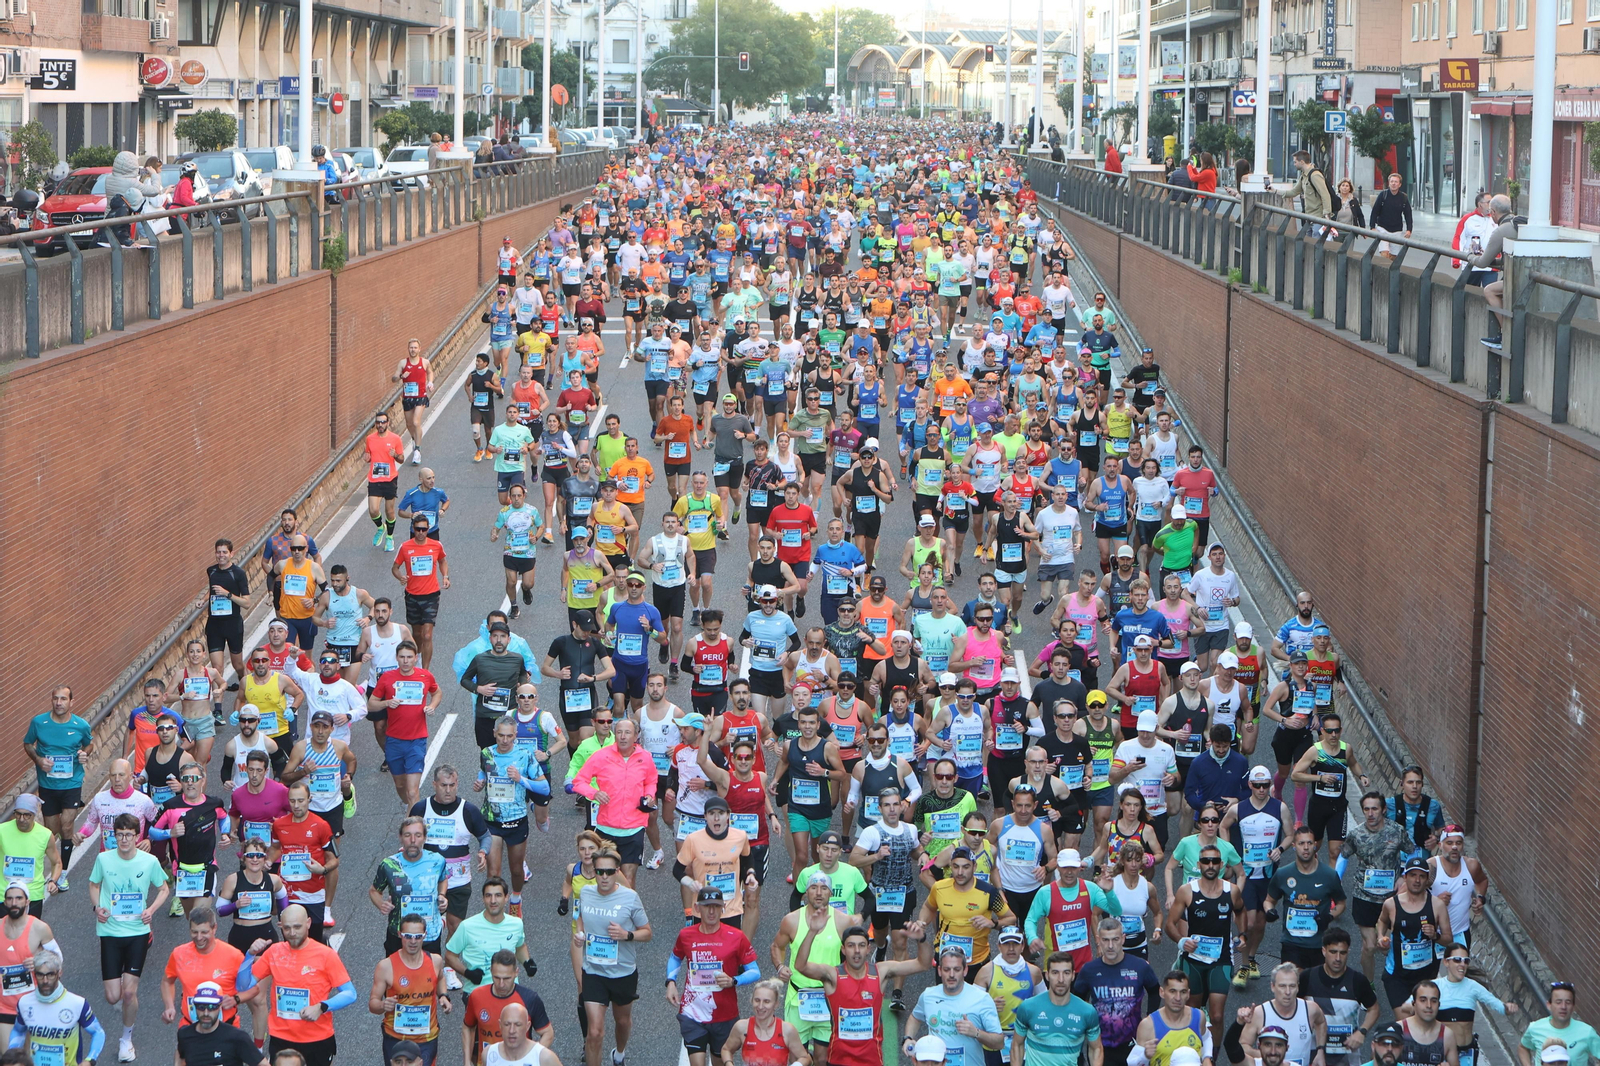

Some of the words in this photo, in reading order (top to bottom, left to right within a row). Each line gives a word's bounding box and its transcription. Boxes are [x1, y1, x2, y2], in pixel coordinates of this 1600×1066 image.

[144, 66, 166, 80] Cruzcampo
[1555, 100, 1572, 117] DONER
[1574, 100, 1590, 117] KEBAB
[1330, 114, 1342, 130] P
[702, 652, 724, 661] PERÚ
[583, 906, 618, 917] MATTIAS
[1062, 903, 1081, 911] DATO
[1094, 985, 1108, 998] VII
[1110, 986, 1135, 998] TRAIL
